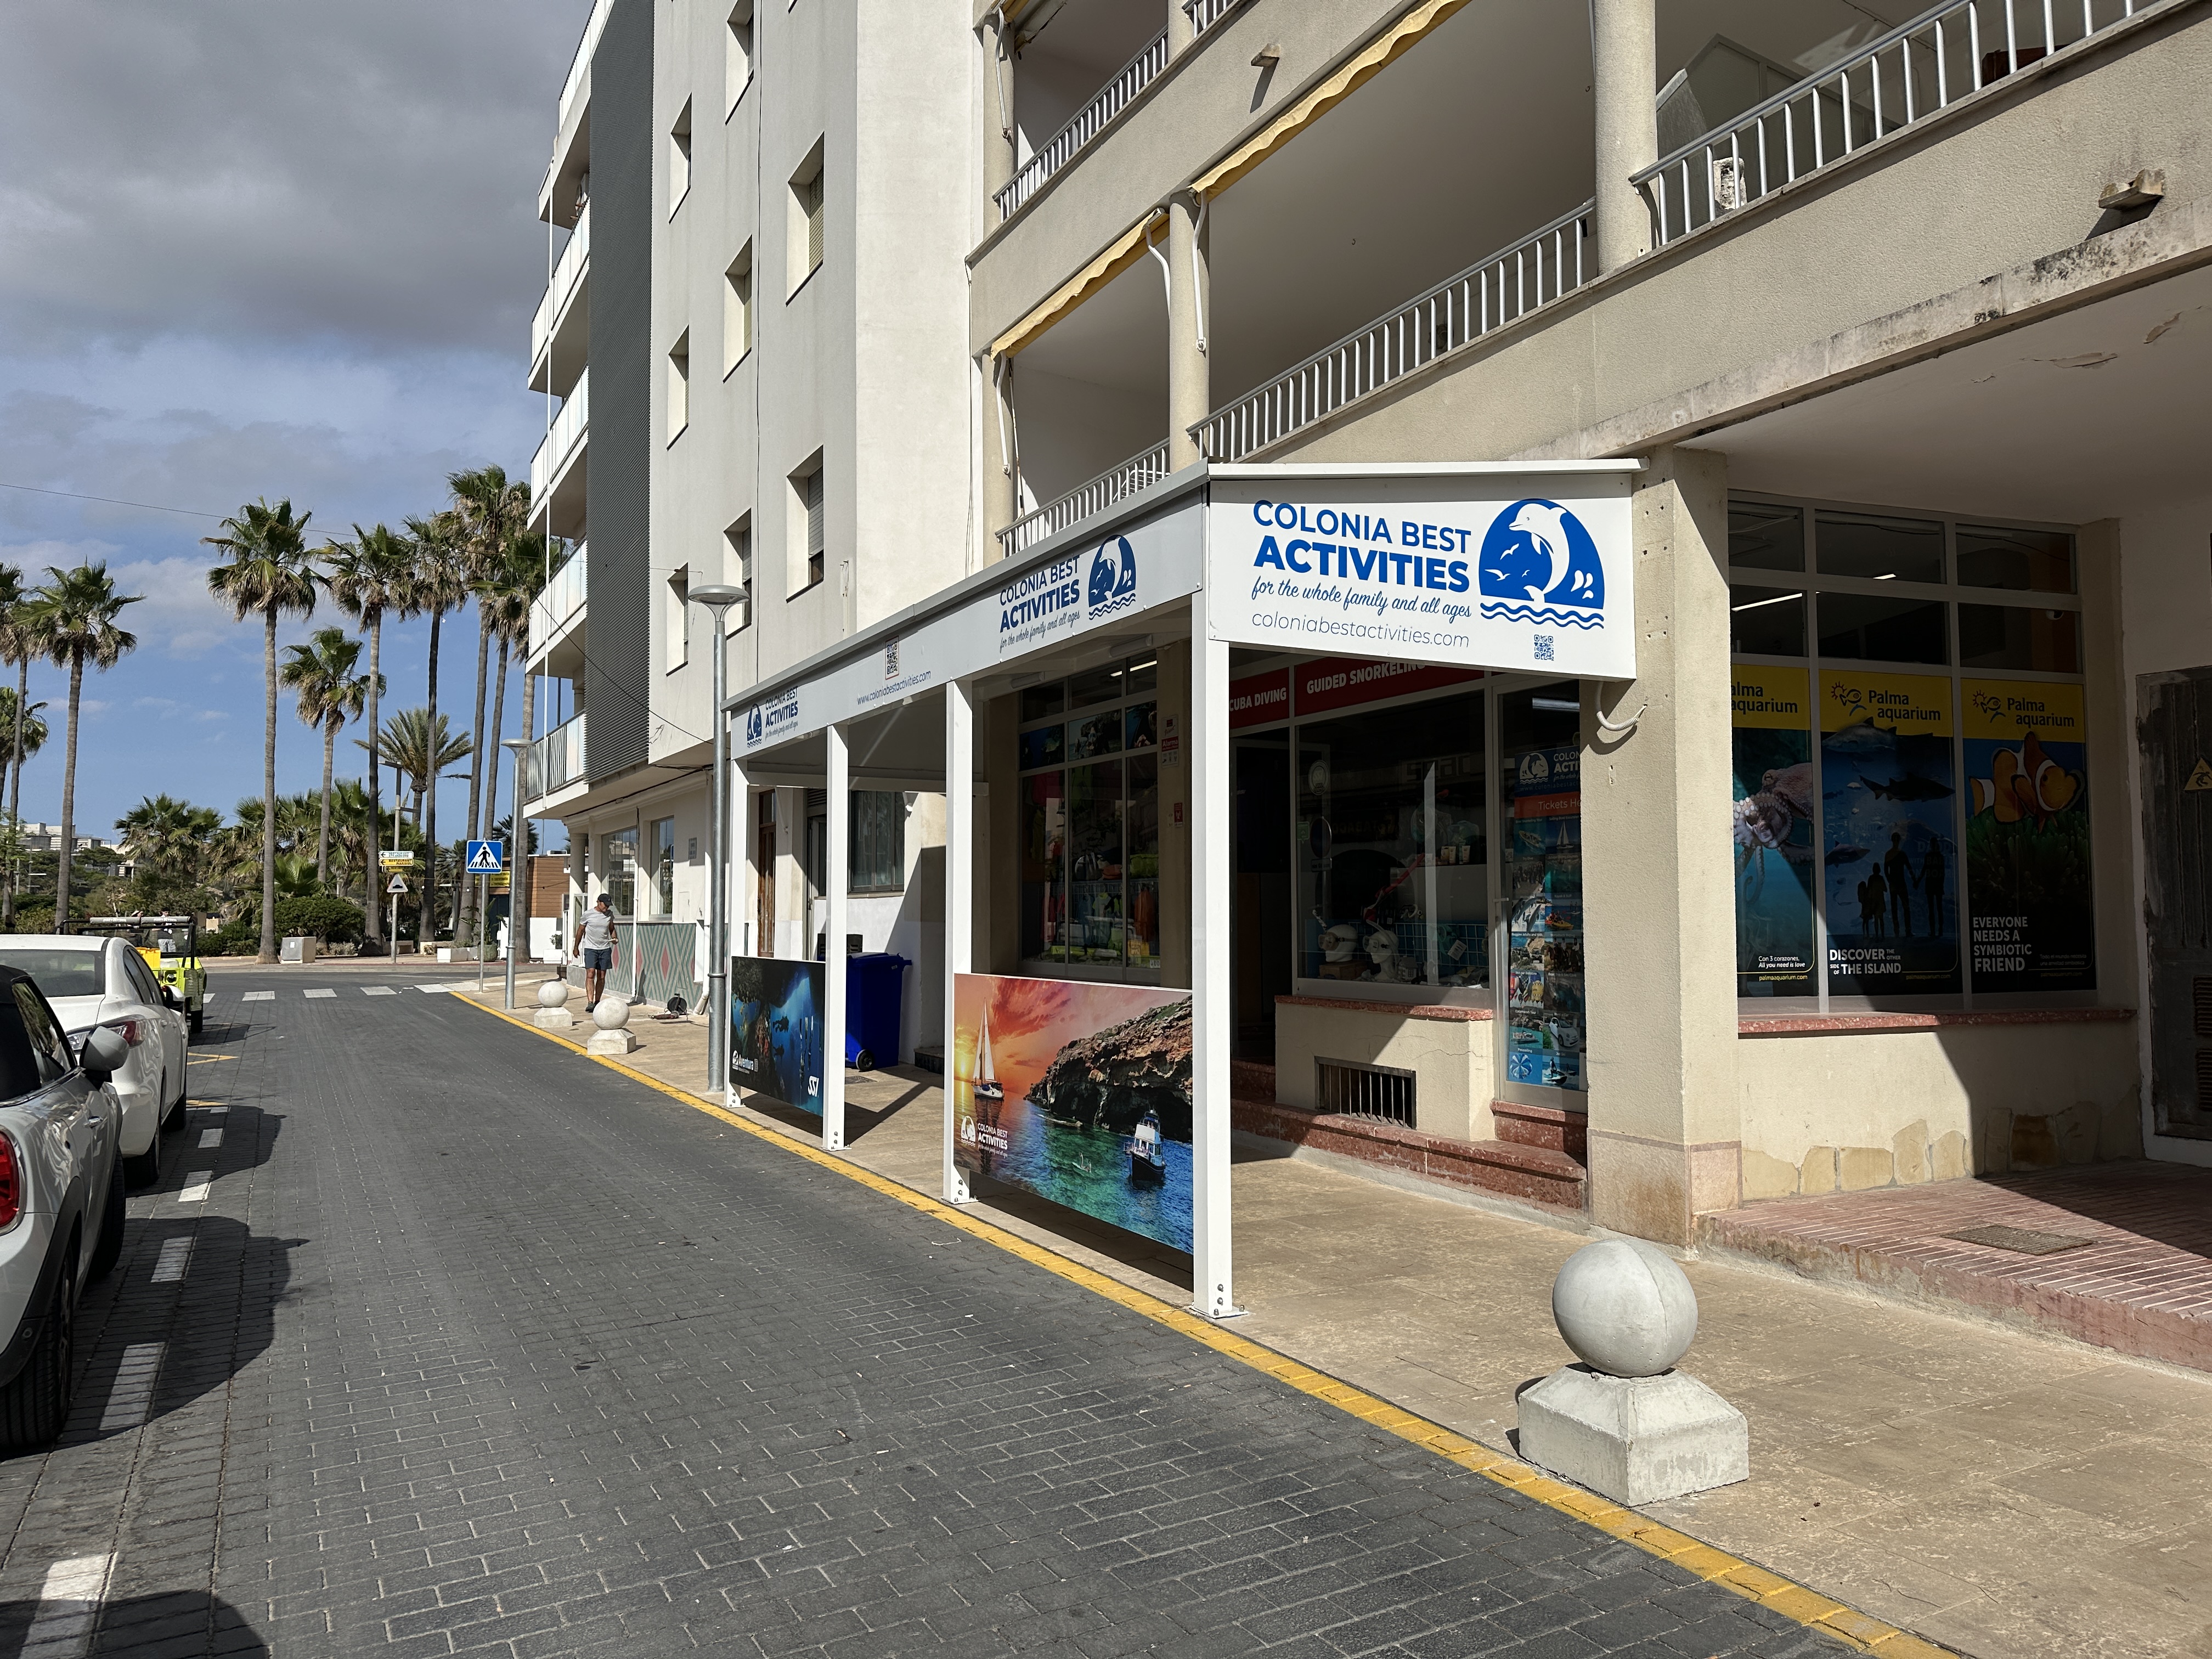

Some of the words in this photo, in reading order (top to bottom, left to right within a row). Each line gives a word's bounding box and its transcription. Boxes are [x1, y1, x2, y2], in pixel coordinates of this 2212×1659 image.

[1253, 500, 1392, 544] COLONIA
[1402, 521, 1471, 554] BEST
[1253, 535, 1470, 593] ACTIVITIES
[1000, 571, 1047, 606] COLONIA
[1051, 555, 1080, 584] BEST
[1000, 579, 1080, 633] ACTIVITIES
[1251, 575, 1274, 600] for
[1278, 579, 1299, 598] the
[1302, 583, 1342, 603] whole
[1344, 587, 1388, 616] family
[1392, 595, 1417, 611] and
[1420, 597, 1440, 614] all
[1442, 603, 1472, 624] ages
[1015, 628, 1029, 642] whole
[1029, 621, 1047, 642] family
[1047, 615, 1058, 630] and
[1058, 612, 1067, 626] all
[1067, 610, 1080, 628] ages
[1252, 611, 1469, 648] coloniabestactivities.com
[857, 670, 931, 705] www.coloniabestactivities.com
[1306, 673, 1347, 695] GUIDED
[1731, 682, 1763, 697] alma
[765, 692, 786, 710] COLONIA
[786, 686, 798, 701] BEST
[1229, 695, 1252, 712] CUBA
[1254, 687, 1286, 707] DIVING
[1731, 698, 1798, 714] aquarium
[1868, 690, 1909, 706] Palma
[2007, 697, 2045, 712] Palma
[765, 701, 798, 728] ACTIVITIES
[1877, 707, 1941, 722] aquarium
[2016, 713, 2074, 729] aquarium
[1554, 751, 1580, 761] COLON
[1554, 760, 1580, 773] ACTI
[1538, 800, 1568, 810] Tickets
[1570, 799, 1581, 808] He
[1973, 917, 2028, 928] EVERYONE
[1973, 930, 2010, 941] NEEDS
[2012, 930, 2021, 941] A
[1830, 949, 1886, 961] DISCOVER
[1973, 944, 2032, 956] SYMBIOTIC
[1841, 964, 1861, 974] THE
[1864, 963, 1901, 974] ISLAND
[1975, 957, 2025, 972] FRIEND
[808, 1075, 820, 1097] SSI
[978, 1122, 996, 1136] COLONIA
[997, 1128, 1008, 1138] BEST
[978, 1132, 1008, 1150] ACTIVITIES
